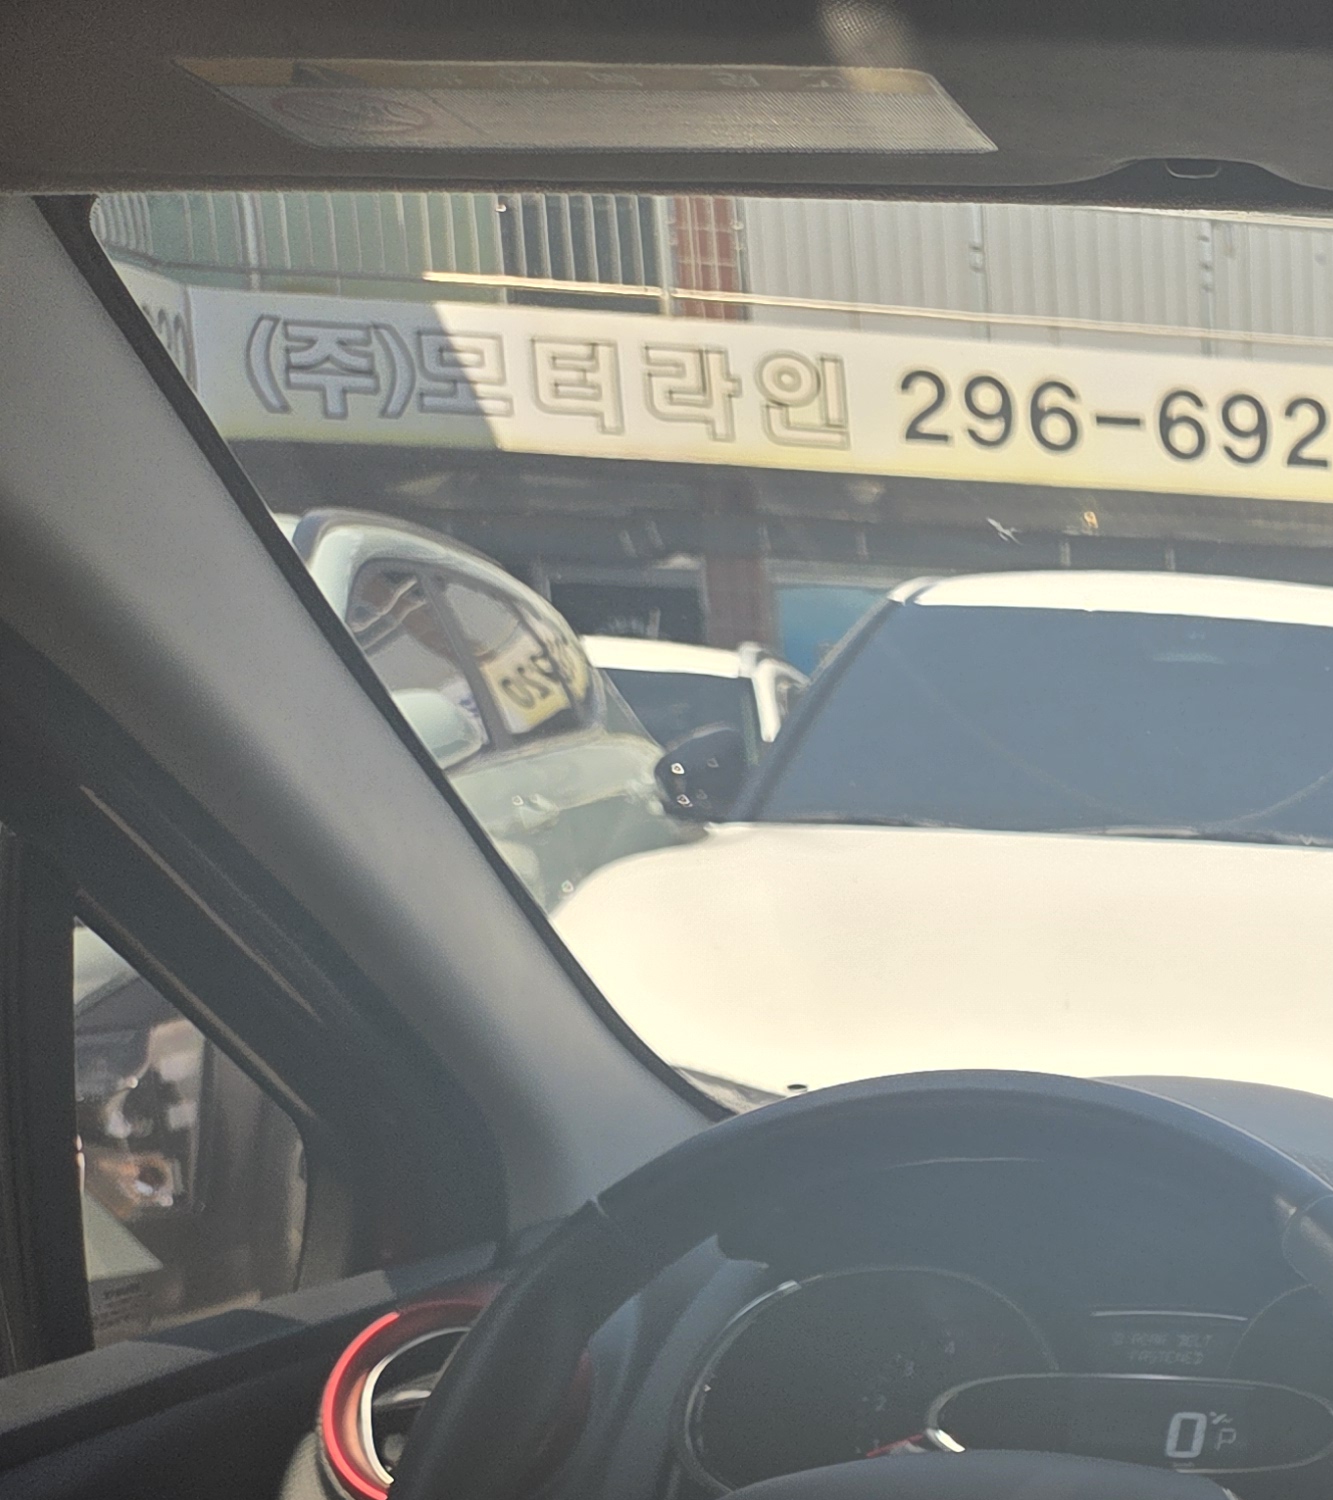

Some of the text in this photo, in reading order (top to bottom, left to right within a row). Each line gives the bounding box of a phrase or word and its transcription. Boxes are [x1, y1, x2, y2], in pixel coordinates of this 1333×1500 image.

[245, 312, 852, 450] (주)모터라인
[1165, 1411, 1237, 1459] 0 P
